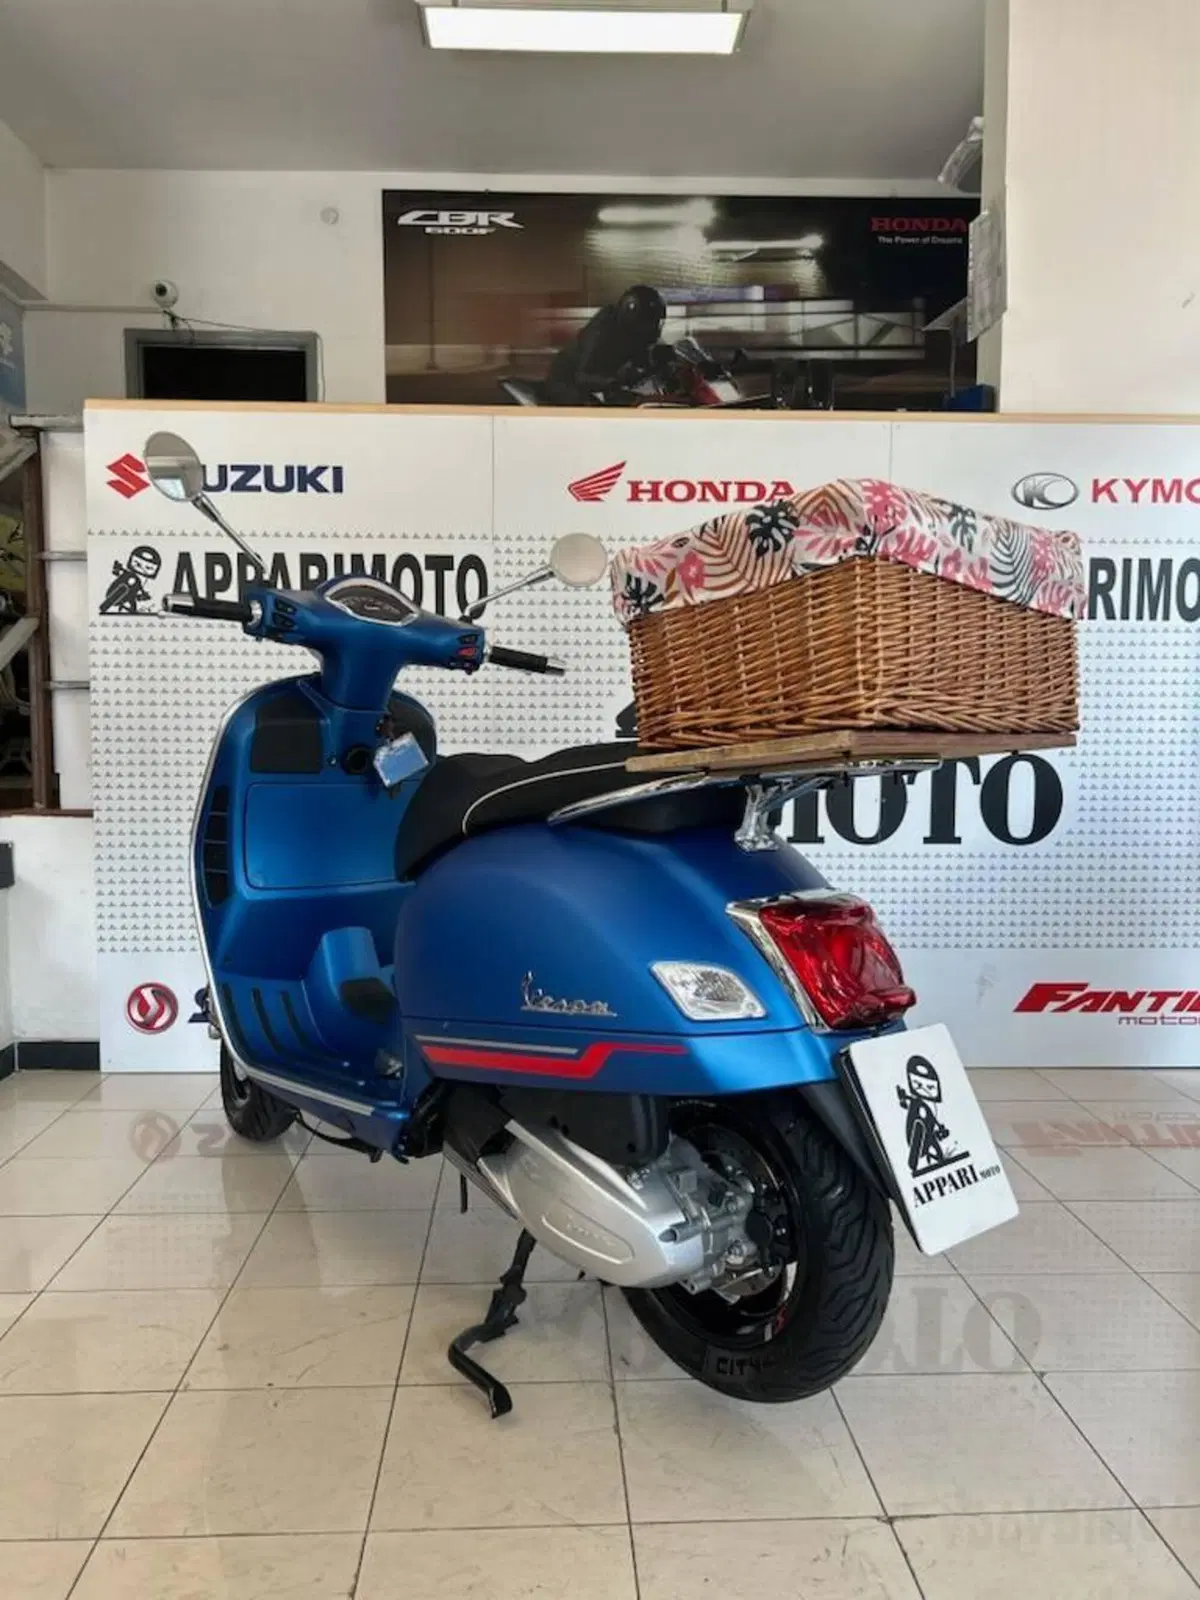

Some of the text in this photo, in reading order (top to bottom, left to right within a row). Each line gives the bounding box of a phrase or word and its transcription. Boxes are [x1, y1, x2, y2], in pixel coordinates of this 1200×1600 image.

[397, 210, 525, 228] CBR
[871, 217, 968, 233] HONDA
[201, 465, 344, 494] UZUKI
[626, 480, 795, 503] HONDA
[1077, 557, 1200, 622] RIMO
[1117, 1015, 1200, 1026] moto
[913, 1164, 1001, 1208] APPARI MOTO
